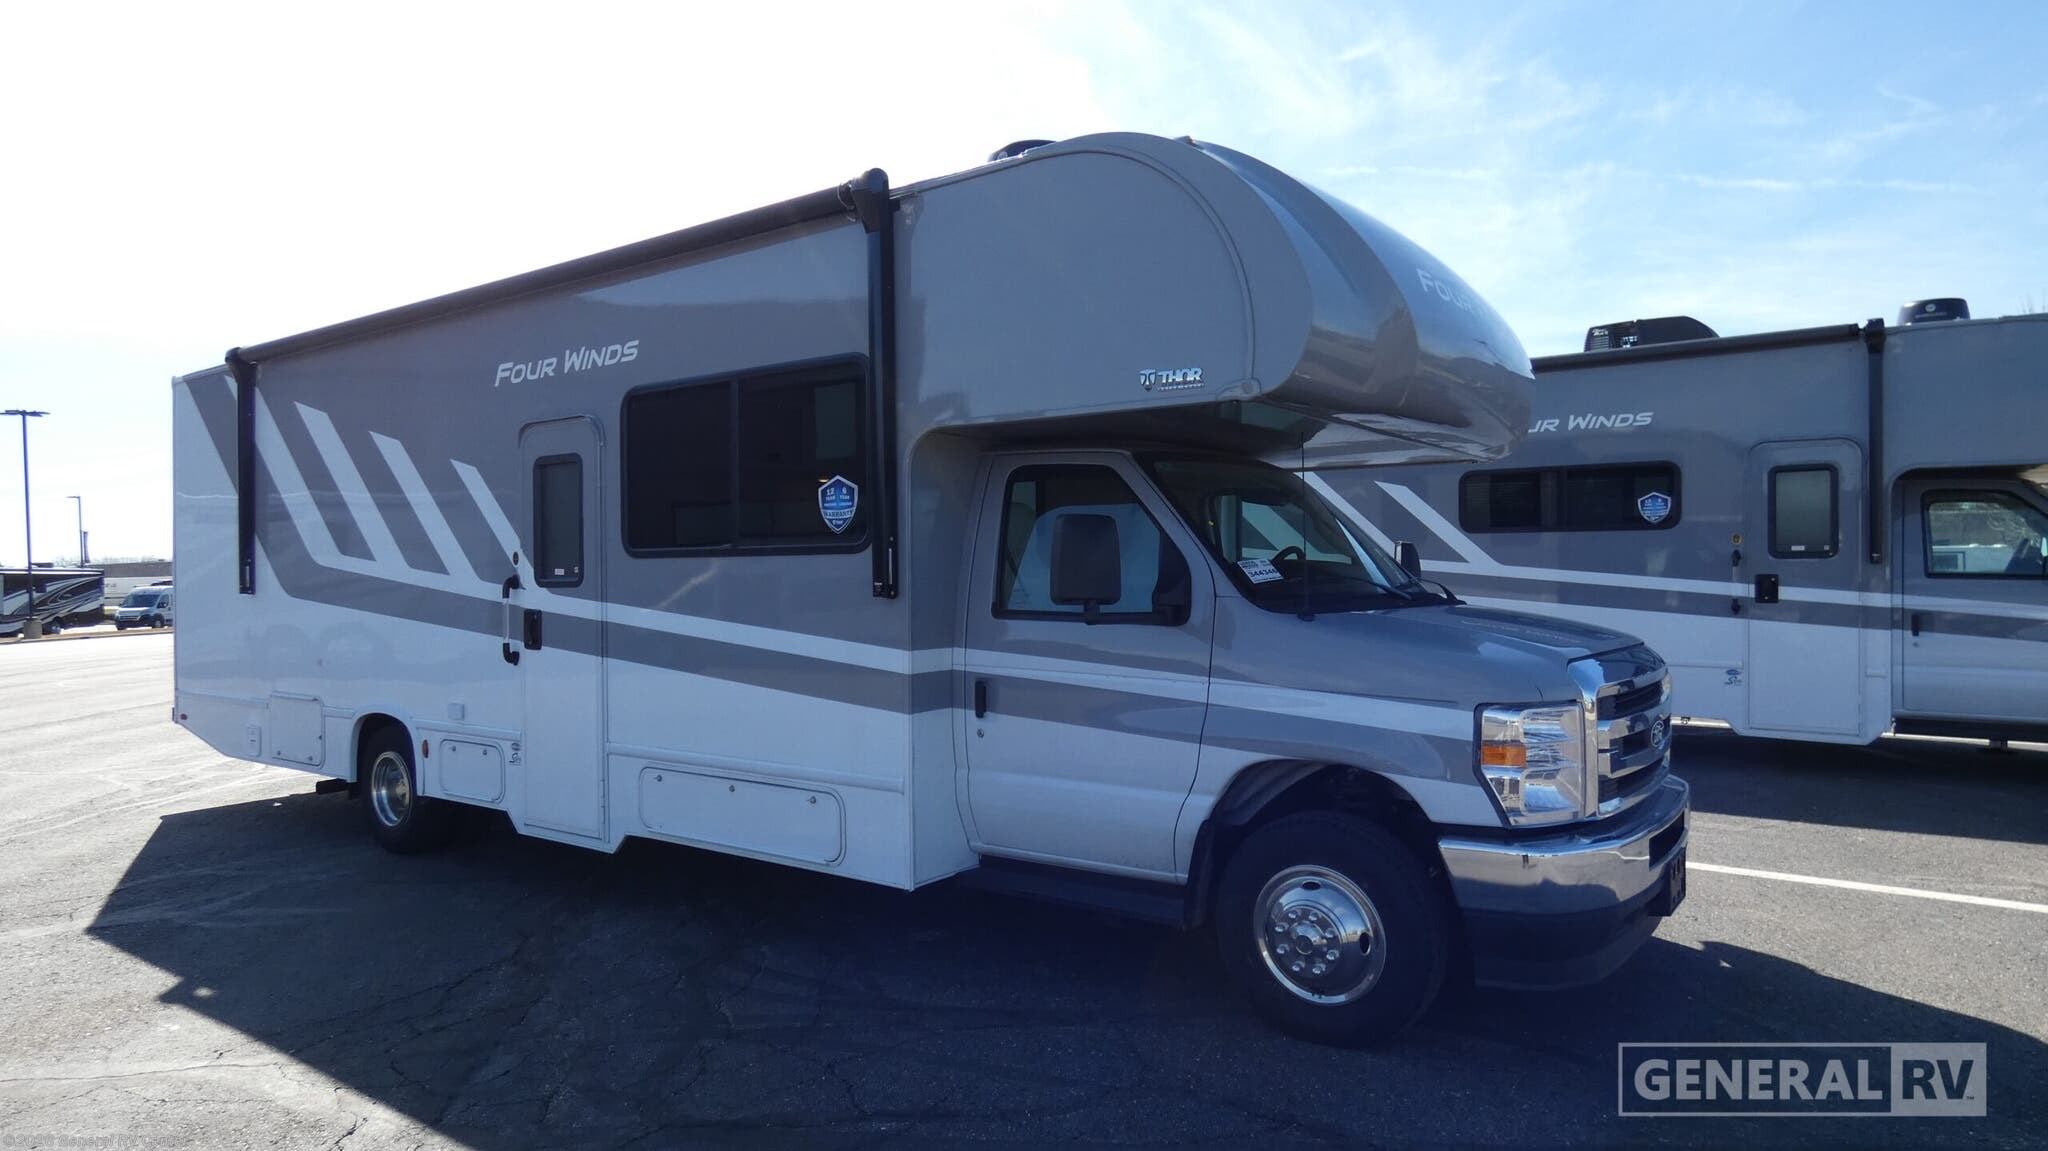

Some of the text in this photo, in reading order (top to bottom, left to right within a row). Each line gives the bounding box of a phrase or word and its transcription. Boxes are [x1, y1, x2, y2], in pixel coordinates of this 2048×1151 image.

[494, 340, 640, 387] FOUR WINDS
[1157, 368, 1203, 384] THOR
[1528, 412, 1654, 433] UR WINDS
